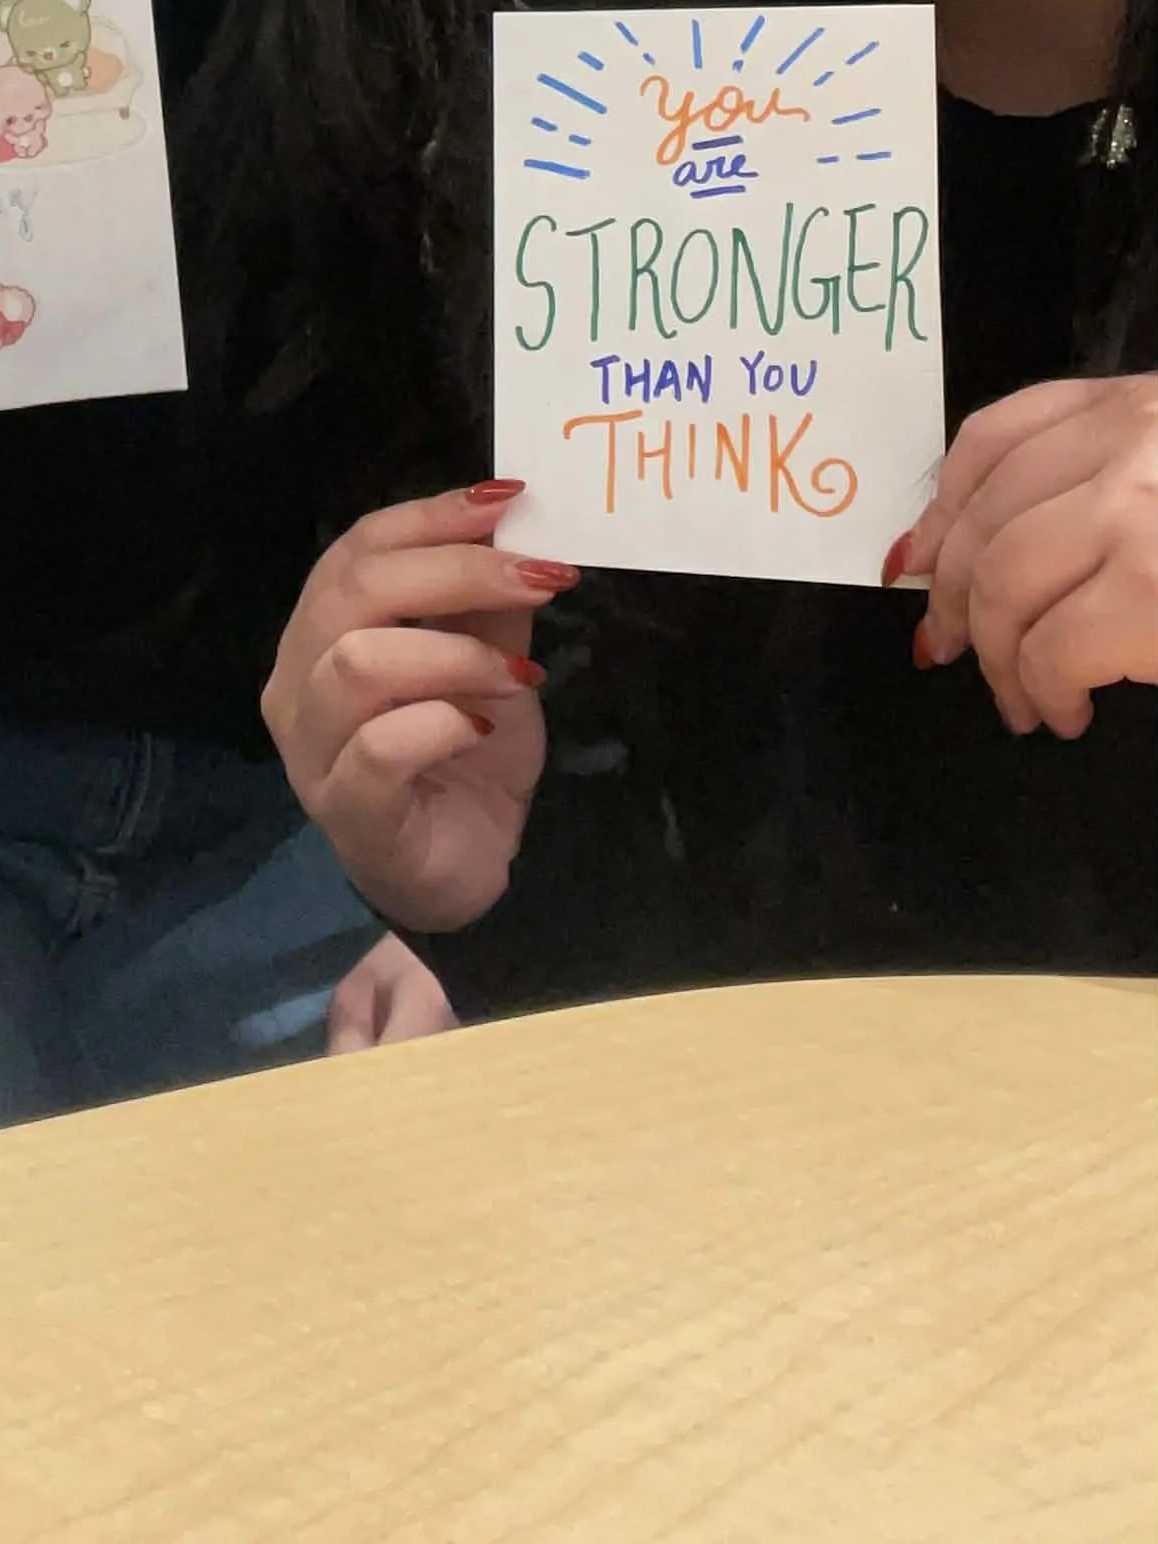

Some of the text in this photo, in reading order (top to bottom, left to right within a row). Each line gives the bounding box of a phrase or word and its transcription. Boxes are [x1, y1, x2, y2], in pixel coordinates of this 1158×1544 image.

[672, 150, 759, 187] are
[515, 201, 929, 352] STRONGER
[590, 350, 819, 405] THAN YOU
[563, 409, 859, 518] THINK
